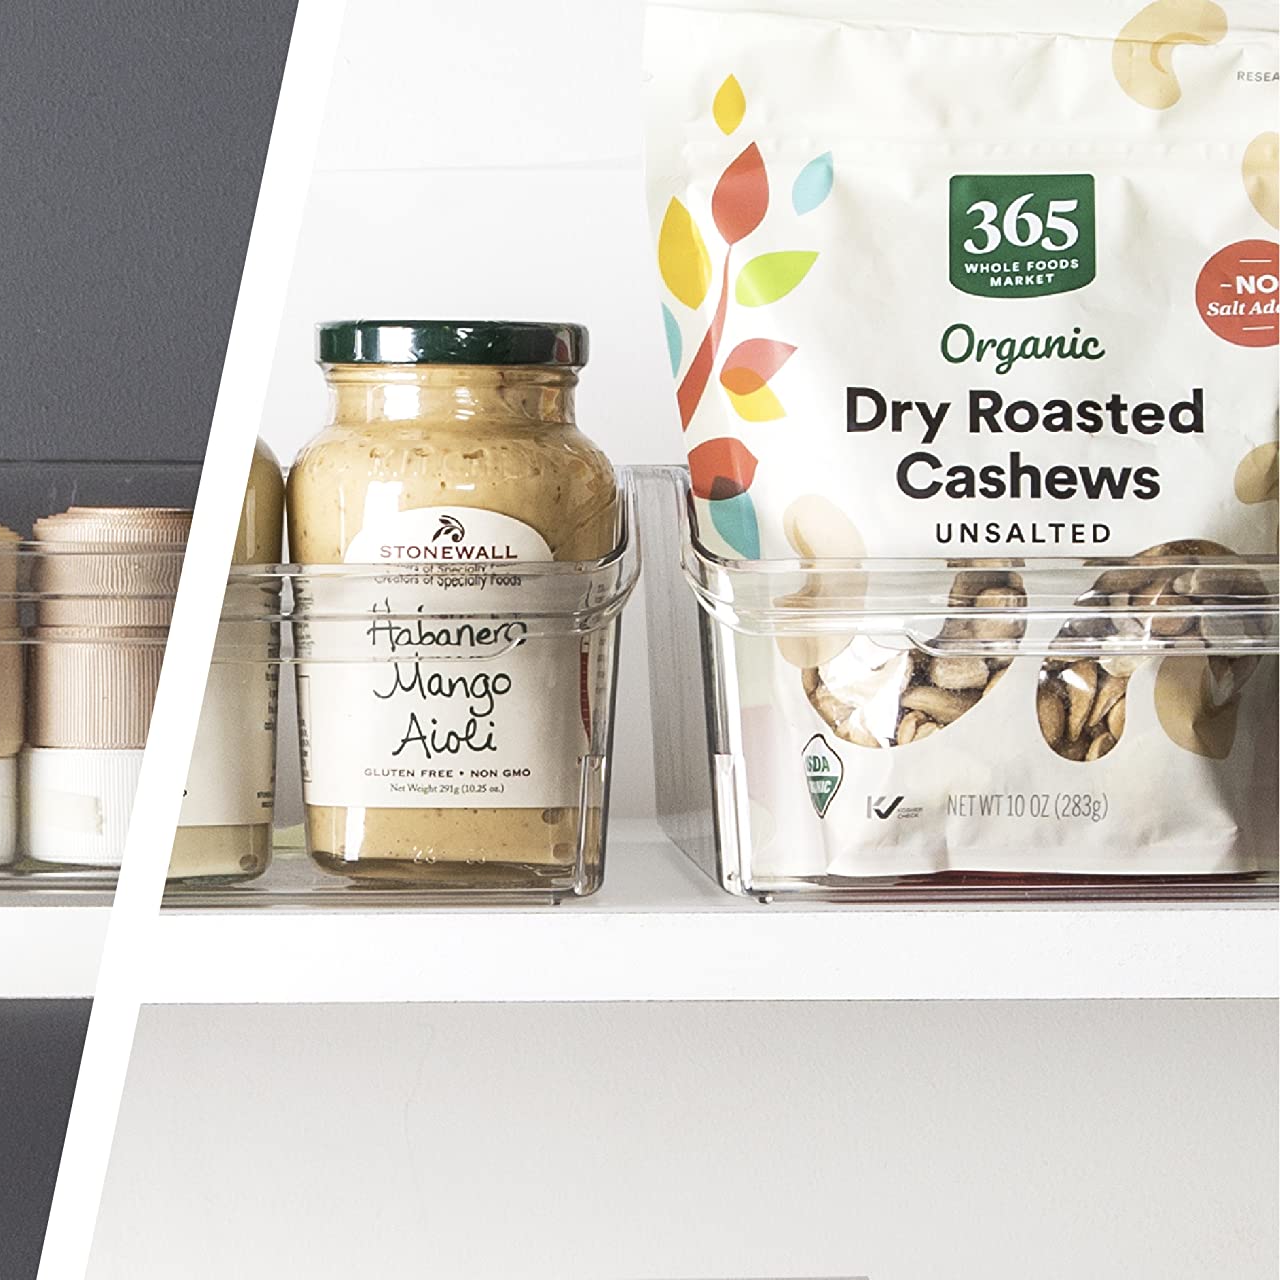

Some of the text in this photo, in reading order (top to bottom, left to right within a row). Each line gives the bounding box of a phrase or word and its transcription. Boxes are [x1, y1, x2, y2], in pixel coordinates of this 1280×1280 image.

[963, 192, 1079, 254] 365
[964, 259, 1079, 273] WHOLE FOODS
[990, 273, 1055, 287] MARKET
[1206, 300, 1246, 316] Salt
[941, 322, 1106, 375] Organic
[846, 387, 1205, 444] Dry Roasted
[896, 451, 1162, 501] Cashews
[935, 522, 1112, 545] UNSALTED
[380, 545, 518, 560] STONEWALL
[372, 657, 512, 719] Mango
[392, 713, 498, 759] Aioli
[364, 768, 532, 778] GLUTEN FREE NON GMO
[390, 783, 505, 795] Net Weight 291g (10.25 oz.)
[946, 792, 1109, 823] NET WT 10 OZ (283g)
